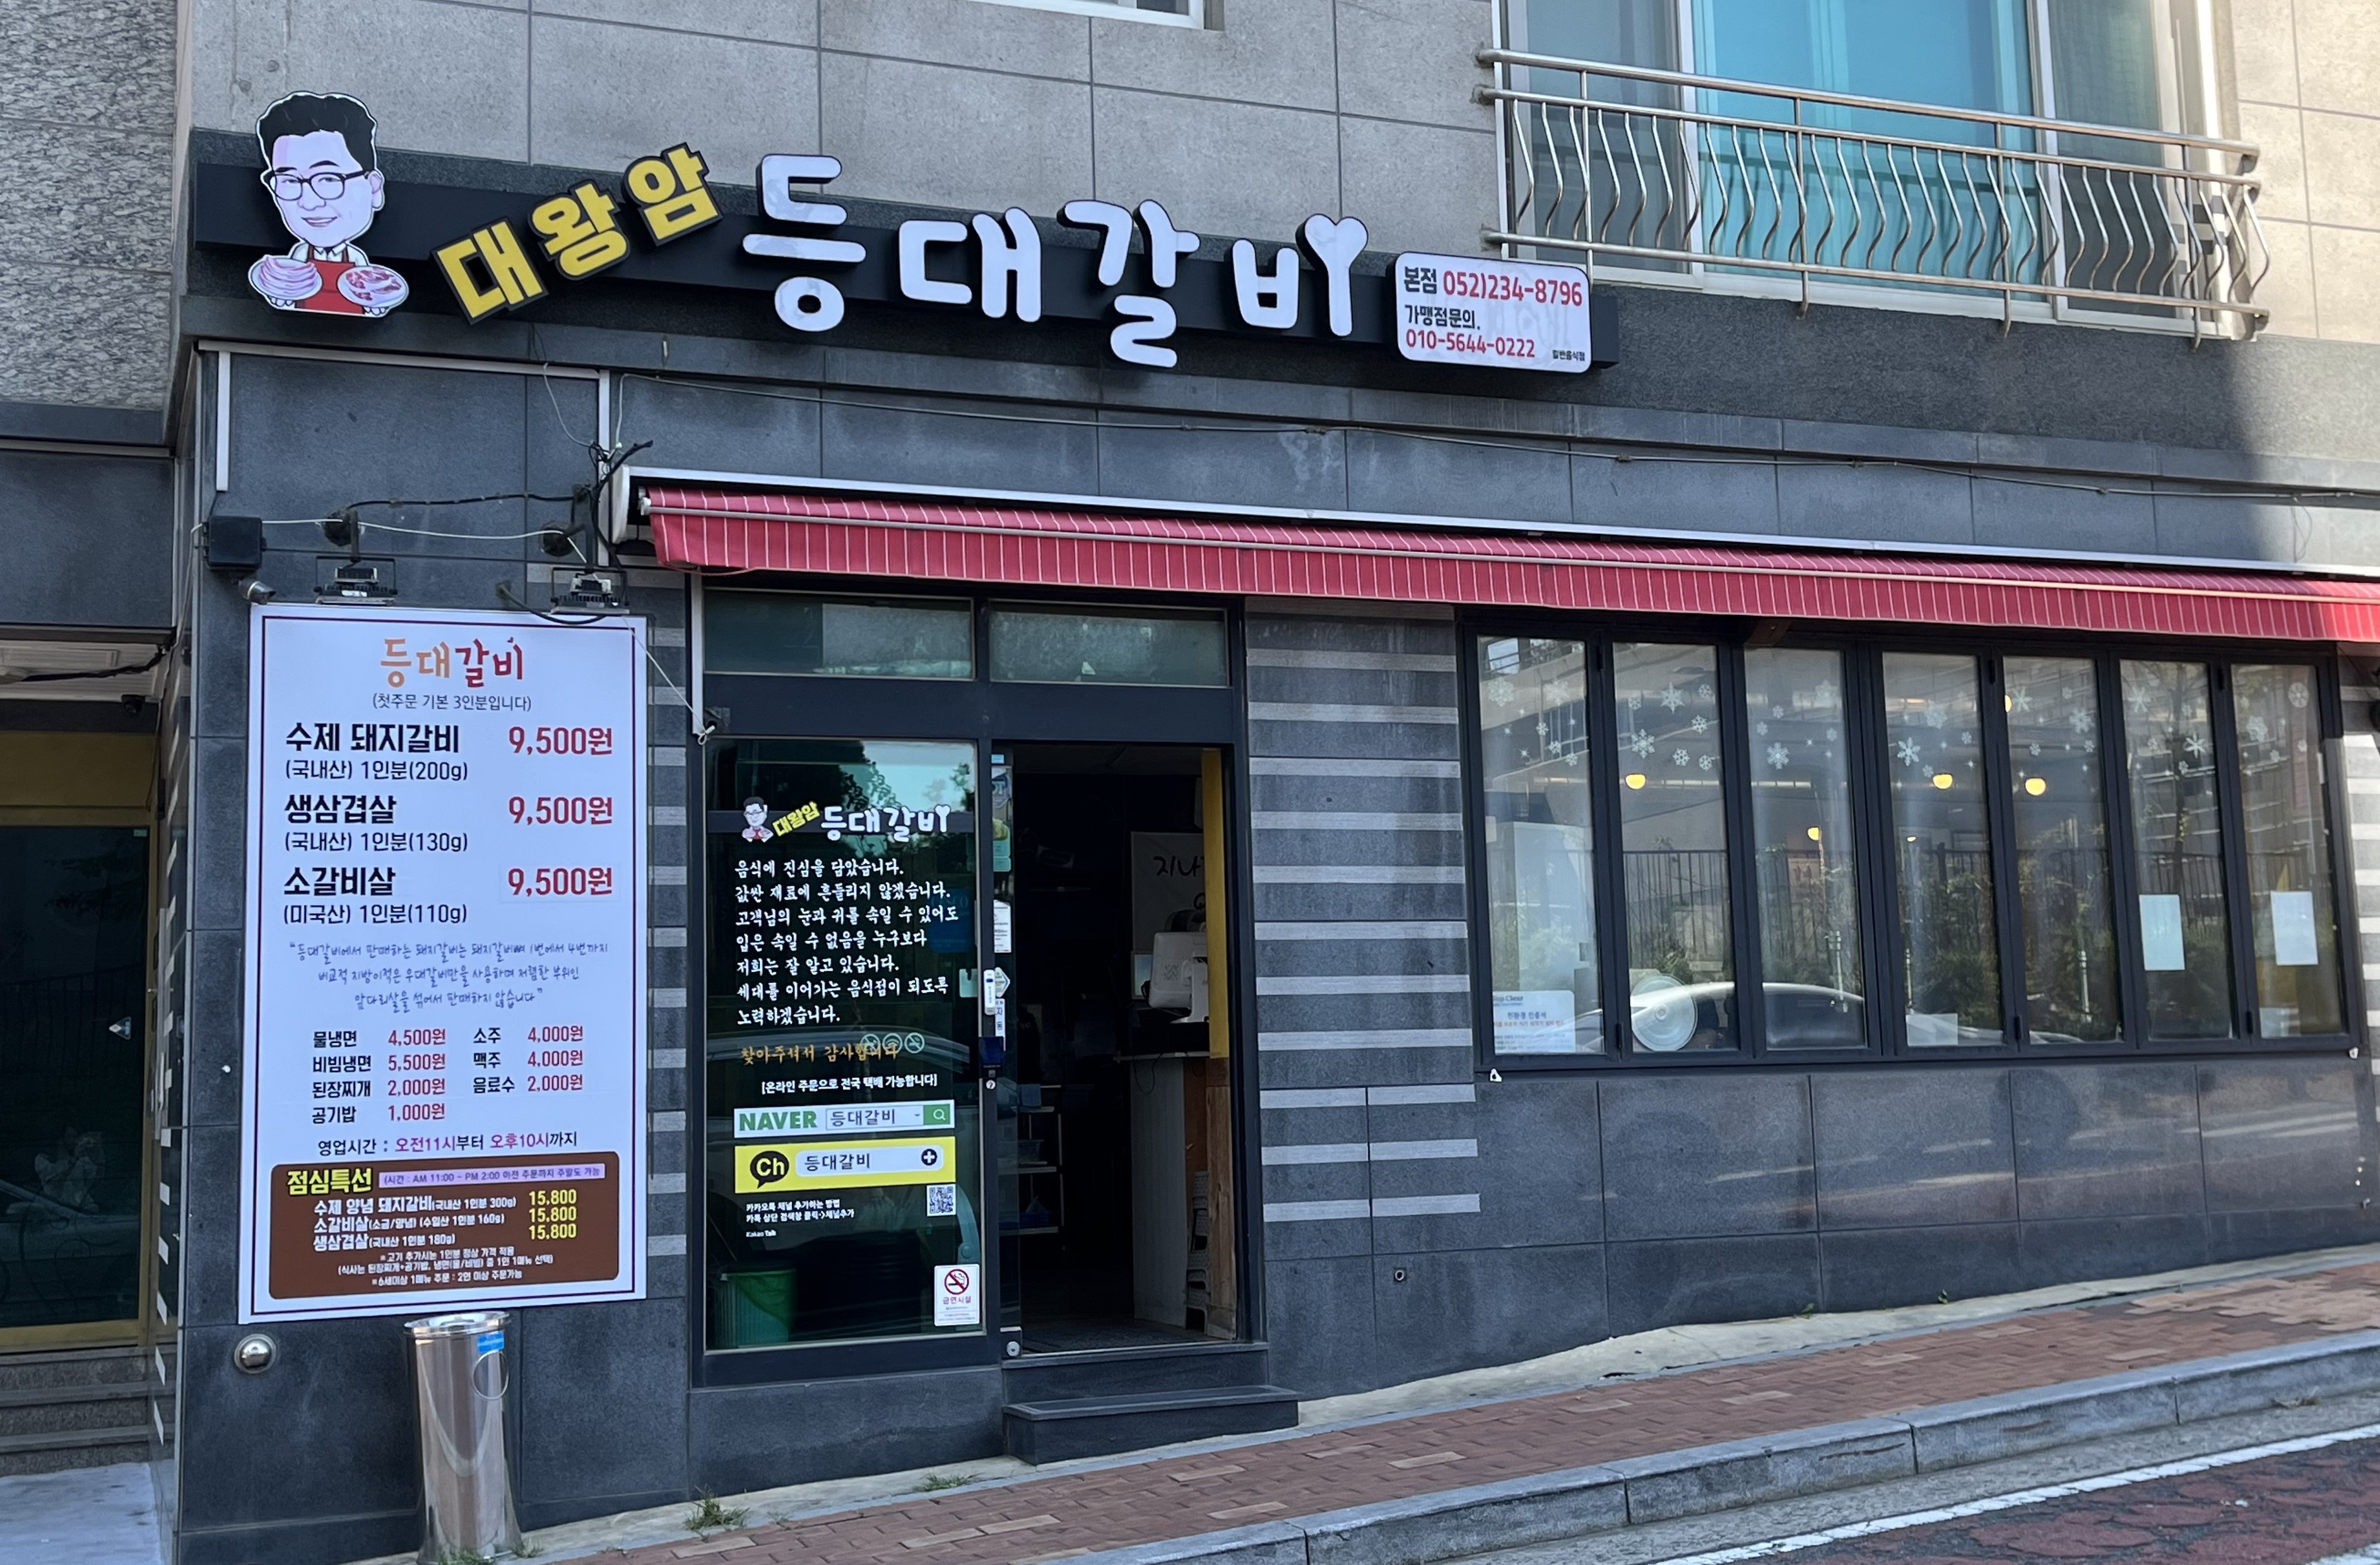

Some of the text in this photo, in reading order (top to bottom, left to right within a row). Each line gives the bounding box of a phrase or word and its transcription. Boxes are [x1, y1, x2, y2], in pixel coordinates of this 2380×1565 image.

[433, 142, 1369, 367] 대왕암 등대갈비
[1405, 266, 1582, 306] 본점 052)234-8796
[1405, 305, 1480, 330] 가맹점문의.
[1406, 329, 1535, 358] 010-5644-0222
[380, 637, 523, 688] 등대갈비
[373, 694, 531, 711] (첫주문 기본 3인분입니다)
[286, 723, 613, 755] 수제 돼지갈비 9,500원
[285, 761, 468, 781] (국내산) 1인분(200g)
[285, 794, 613, 825] 생삼겹살 9,500원
[772, 801, 951, 842] 대왕암 등대갈비
[285, 832, 468, 852] (국내산) 1인분(130g)
[735, 858, 904, 878] 음식에 진심을 담았습니다.
[1153, 855, 1205, 877] 지나
[284, 866, 613, 897] 소갈비살 9,500원
[735, 881, 950, 904] 값싼 재료에 흔들리지 않겠습니다.
[283, 904, 467, 924] (미국산) 1인분(110g)
[735, 905, 959, 927] 고객님의 눈과 귀를 속일 수 있어도
[737, 933, 764, 953] 입은
[771, 933, 797, 952] 속일
[804, 933, 818, 950] 수
[825, 931, 866, 950] 없음을
[873, 929, 926, 948] 누구보다
[366, 944, 411, 959] 판매하는
[416, 942, 467, 963] 돼지갈비는
[568, 943, 608, 955] 4번까지
[319, 969, 347, 984] 비교적
[352, 968, 401, 984] 지방이적은
[473, 966, 514, 983] 사용하며
[519, 966, 549, 981] 저렴한
[553, 966, 579, 980] 부위인
[737, 954, 899, 976] 저희는 잘 알고 있습니다.
[737, 976, 948, 1002] 세대를 이어가는 음식점이 되도록
[355, 991, 410, 1013] 앞다리살을
[413, 992, 442, 1008] 섞어서
[447, 992, 491, 1006] 판매하지
[738, 1005, 840, 1026] 노력하겠습니다.
[313, 1025, 583, 1048] 물냉면 4,500원 소주 4,000원
[313, 1050, 583, 1073] 비빔냉면 5,500원 맥주 4,000원
[741, 1042, 898, 1066] 찾아주셔서 감사합니다
[312, 1074, 583, 1099] 된장찌개 2,000원 음료수 2,000원
[762, 1074, 938, 1094] [온라인 주문으로 전국 택배 가능합니다]
[312, 1104, 445, 1124] 공기밥 1,000원
[739, 1111, 817, 1131] NAVER
[830, 1109, 895, 1126] 등대갈비
[318, 1138, 376, 1156] 영업시간
[395, 1135, 484, 1152] 오전11시부터
[490, 1131, 577, 1149] 오후10시까지
[757, 1157, 784, 1176] Ch
[804, 1153, 870, 1171] 등대갈비
[287, 1168, 372, 1195] 점심특선
[384, 1175, 404, 1184] (시간
[431, 1174, 454, 1182] 11:00
[481, 1171, 500, 1180] 2:00
[504, 1171, 519, 1179] 이전
[522, 1169, 554, 1178] 주문까지
[314, 1199, 342, 1215] 수제
[346, 1198, 374, 1214] 양념
[464, 1198, 486, 1208] 1인분
[490, 1197, 517, 1208] 300g)
[529, 1189, 577, 1205] 15,800
[746, 1202, 775, 1212] 카카오톡
[777, 1202, 792, 1211] 채널
[452, 1215, 475, 1225] 1인분
[478, 1214, 505, 1224] 160g)
[529, 1207, 577, 1222] 15,800
[403, 1236, 425, 1246] 1인분
[428, 1234, 456, 1245] 180g)
[529, 1224, 577, 1239] 15,800
[338, 1265, 365, 1275] (식사는
[497, 1256, 510, 1266] 1인
[387, 1252, 403, 1262] 고기
[406, 1251, 437, 1261] 추가시는
[440, 1249, 460, 1259] 1인분
[434, 1273, 449, 1283] 주문
[457, 1272, 471, 1282] 2인
[943, 1296, 971, 1304] 금연시설
